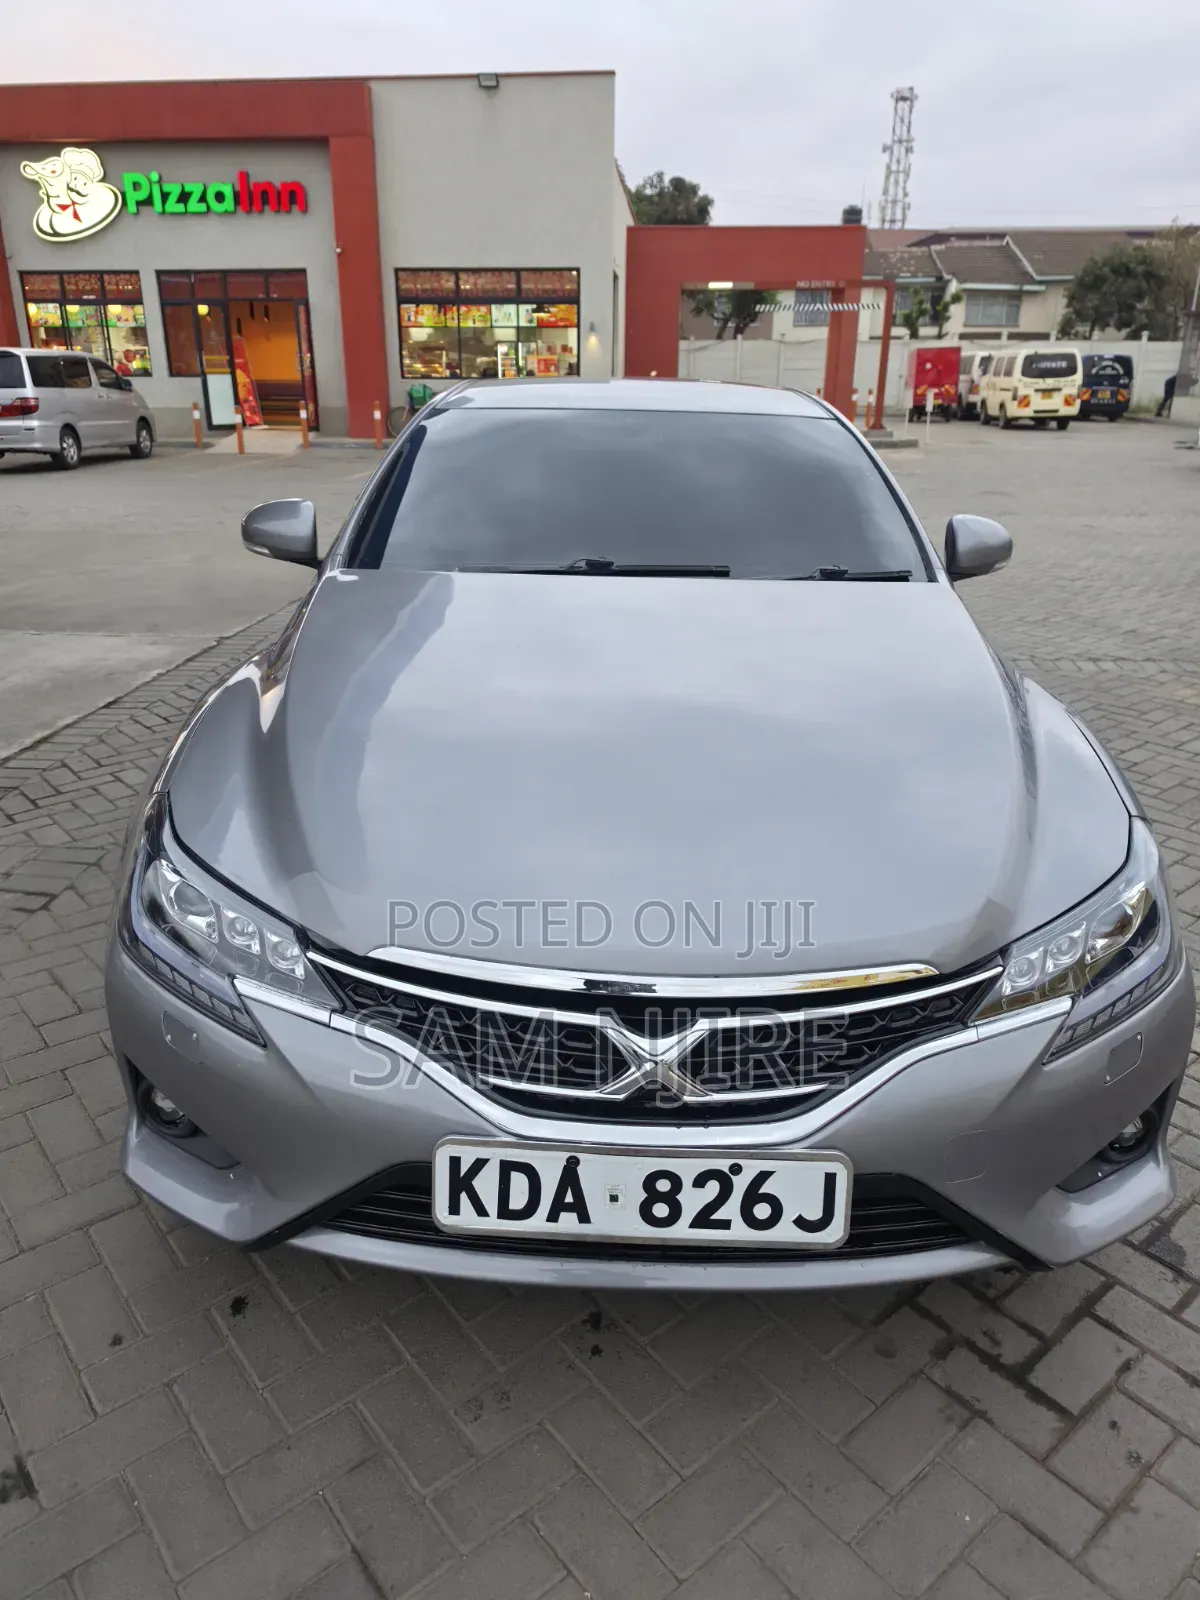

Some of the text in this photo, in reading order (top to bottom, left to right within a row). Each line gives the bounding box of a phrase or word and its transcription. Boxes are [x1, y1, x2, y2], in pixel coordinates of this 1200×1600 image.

[796, 279, 810, 289] NO
[447, 1155, 838, 1234] KDA 826J
